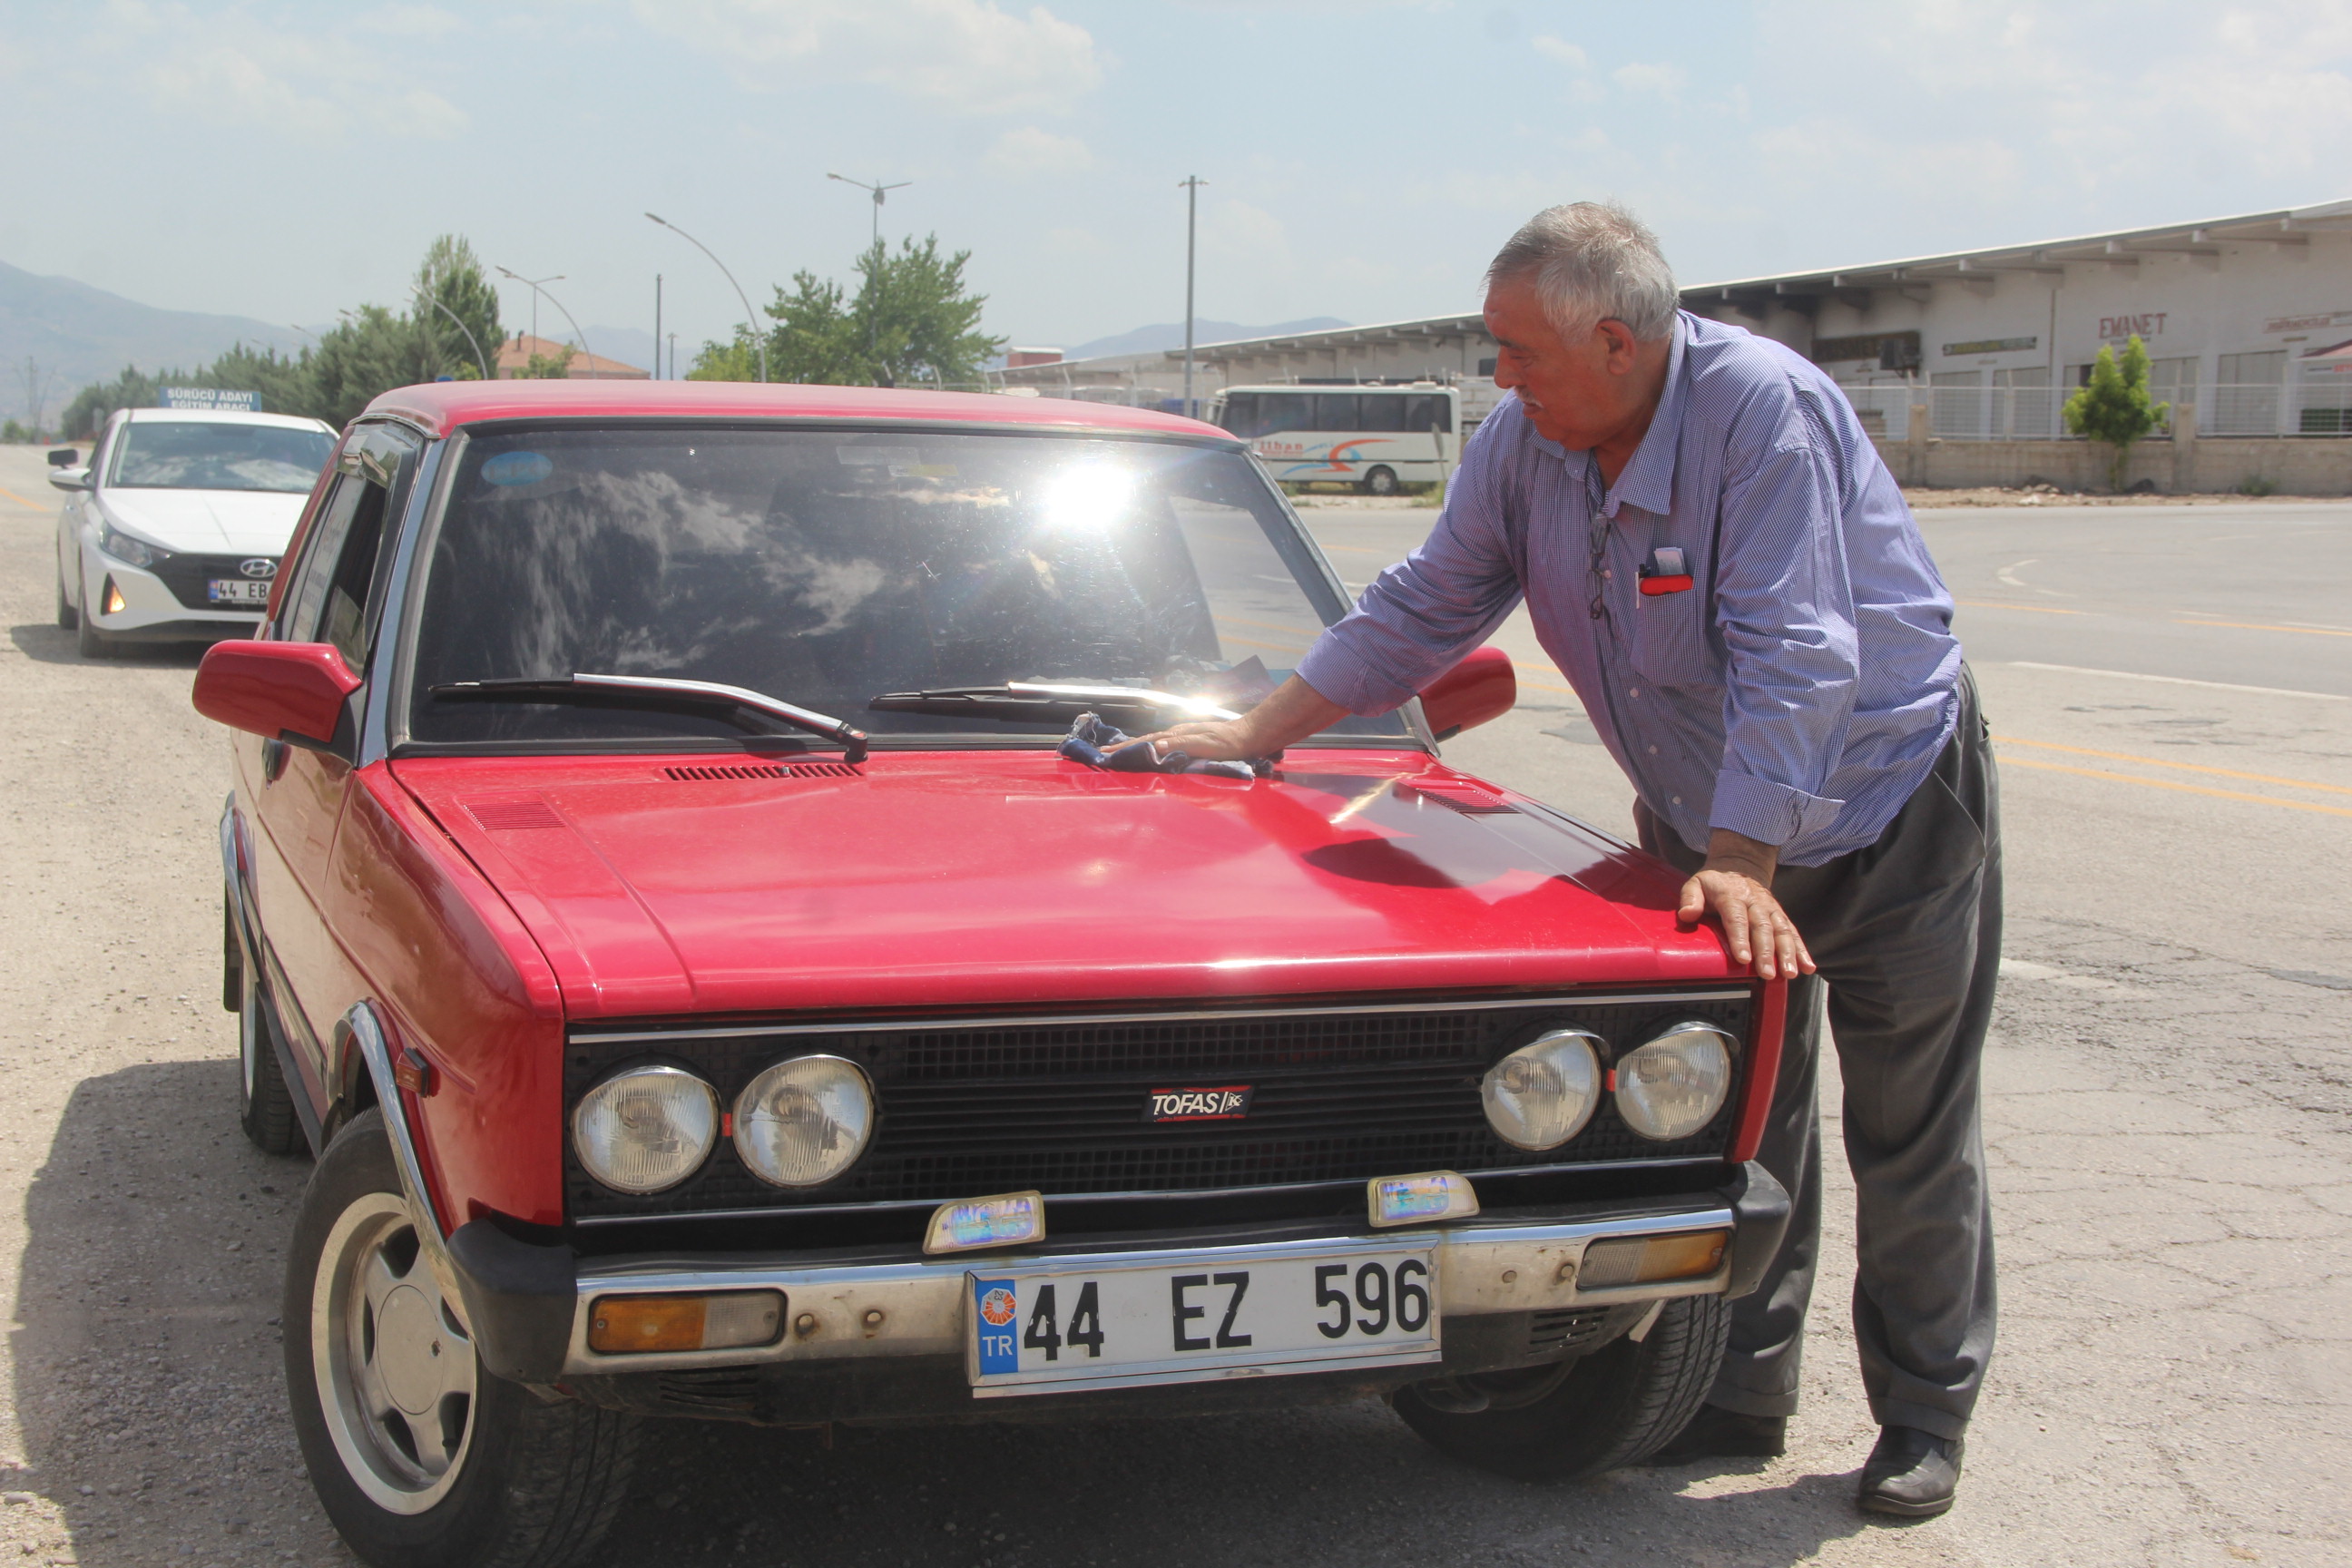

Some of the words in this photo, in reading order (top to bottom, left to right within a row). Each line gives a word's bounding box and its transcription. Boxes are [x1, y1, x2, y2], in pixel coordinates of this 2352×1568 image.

[2099, 312, 2167, 339] EMANET
[167, 387, 216, 400] SÜRÜCÜ
[219, 391, 252, 403] ADAYI
[219, 583, 236, 597] 44
[249, 583, 267, 598] EB
[1023, 1280, 1104, 1361] 44
[1171, 1270, 1252, 1351] EZ
[1315, 1259, 1430, 1339] 596
[982, 1335, 1013, 1357] TR
